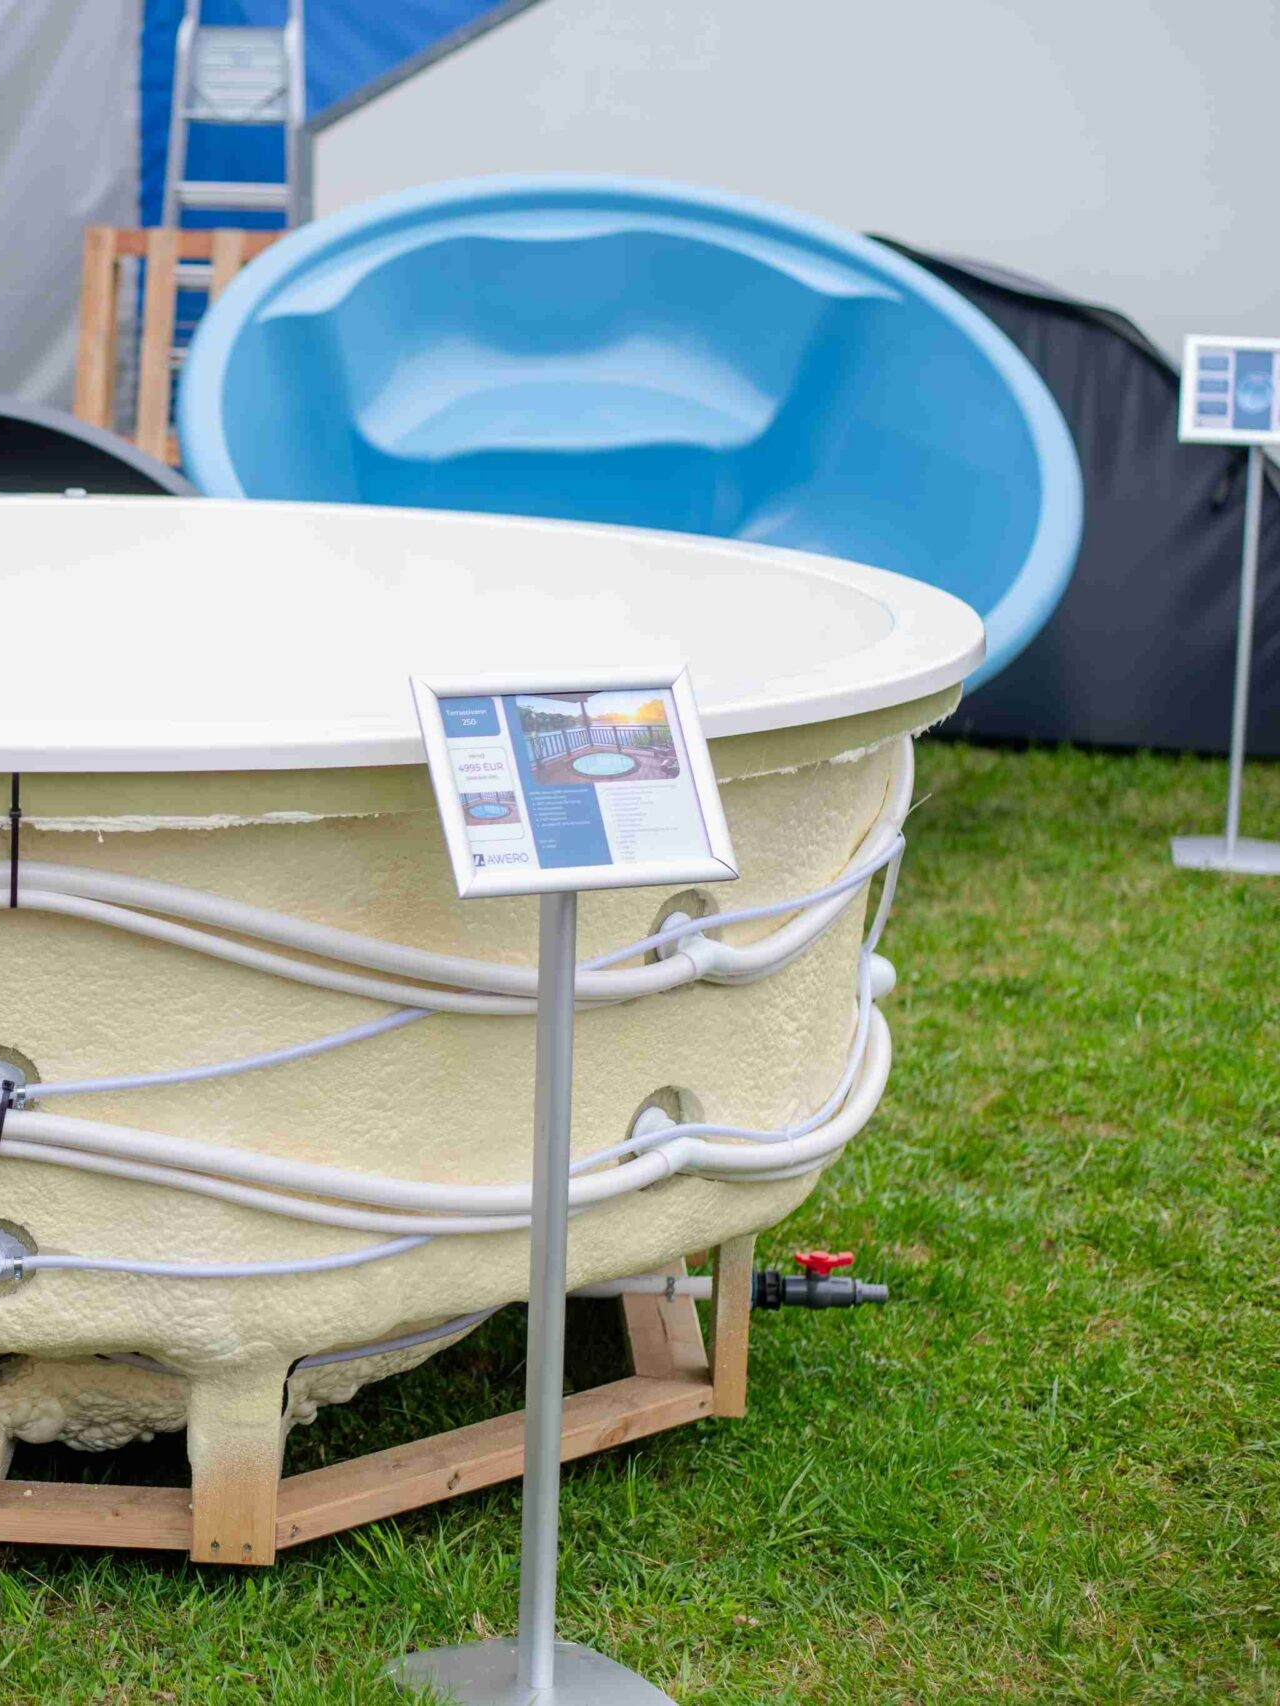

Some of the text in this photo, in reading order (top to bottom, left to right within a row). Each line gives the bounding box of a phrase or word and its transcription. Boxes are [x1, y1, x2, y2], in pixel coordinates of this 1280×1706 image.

[462, 718, 477, 726] 250
[458, 761, 504, 772] 4995 EUR
[487, 852, 529, 864] AWERO
